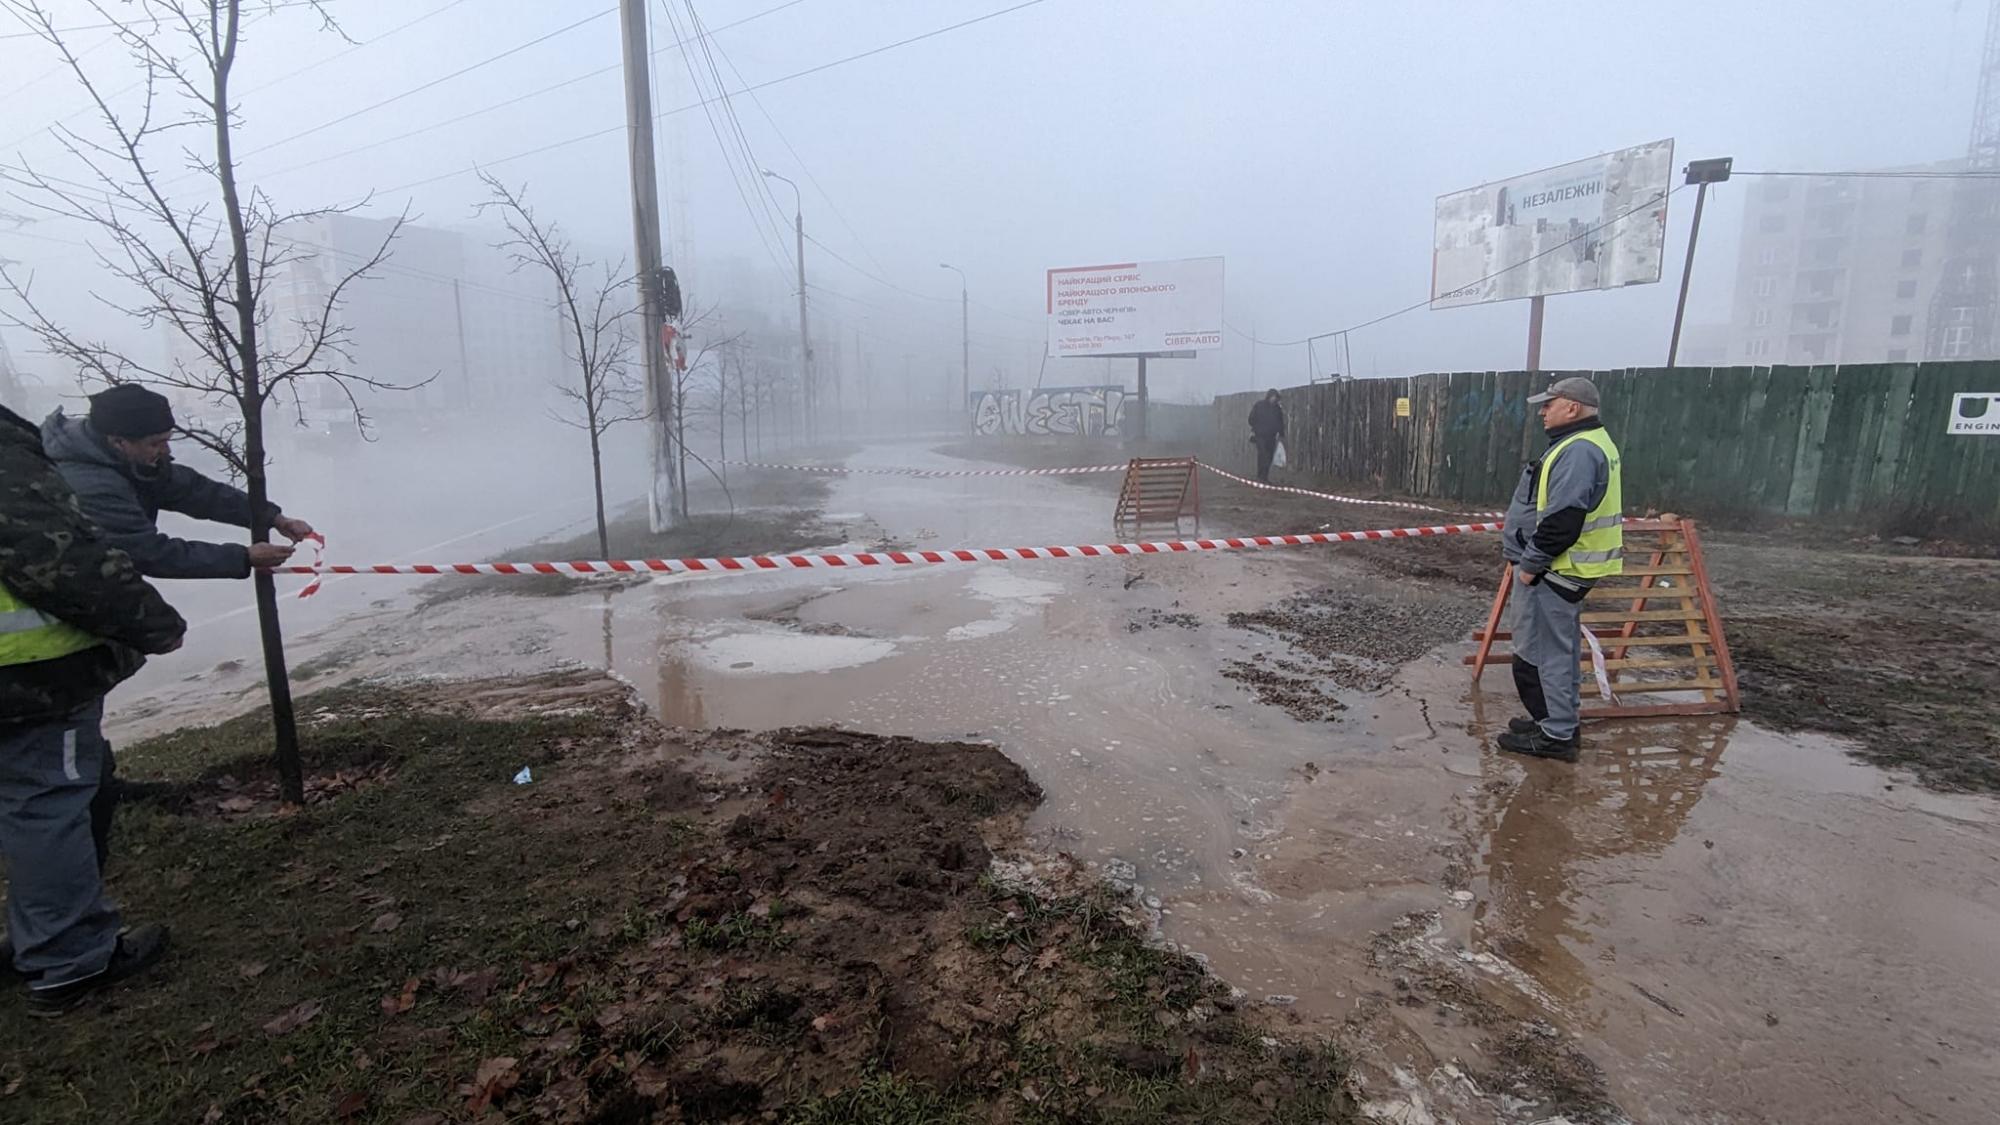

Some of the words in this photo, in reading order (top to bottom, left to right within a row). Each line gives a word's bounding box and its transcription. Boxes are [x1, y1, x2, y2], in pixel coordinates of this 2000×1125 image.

[1522, 181, 1604, 209] НЕЗАЛЕЖНІ
[1057, 276, 1112, 286] НАЙКРАЩИЙ
[1113, 273, 1141, 283] СЕРВІС
[1057, 286, 1117, 298] НАЙКРАЩОГО
[1118, 283, 1176, 295] ЯПОНСЬКОГО
[1057, 298, 1088, 306] БРЕНДУ
[1084, 317, 1095, 325] НА
[1165, 335, 1221, 346] СІВЕР-АВТО
[975, 390, 1125, 436] SWEET!
